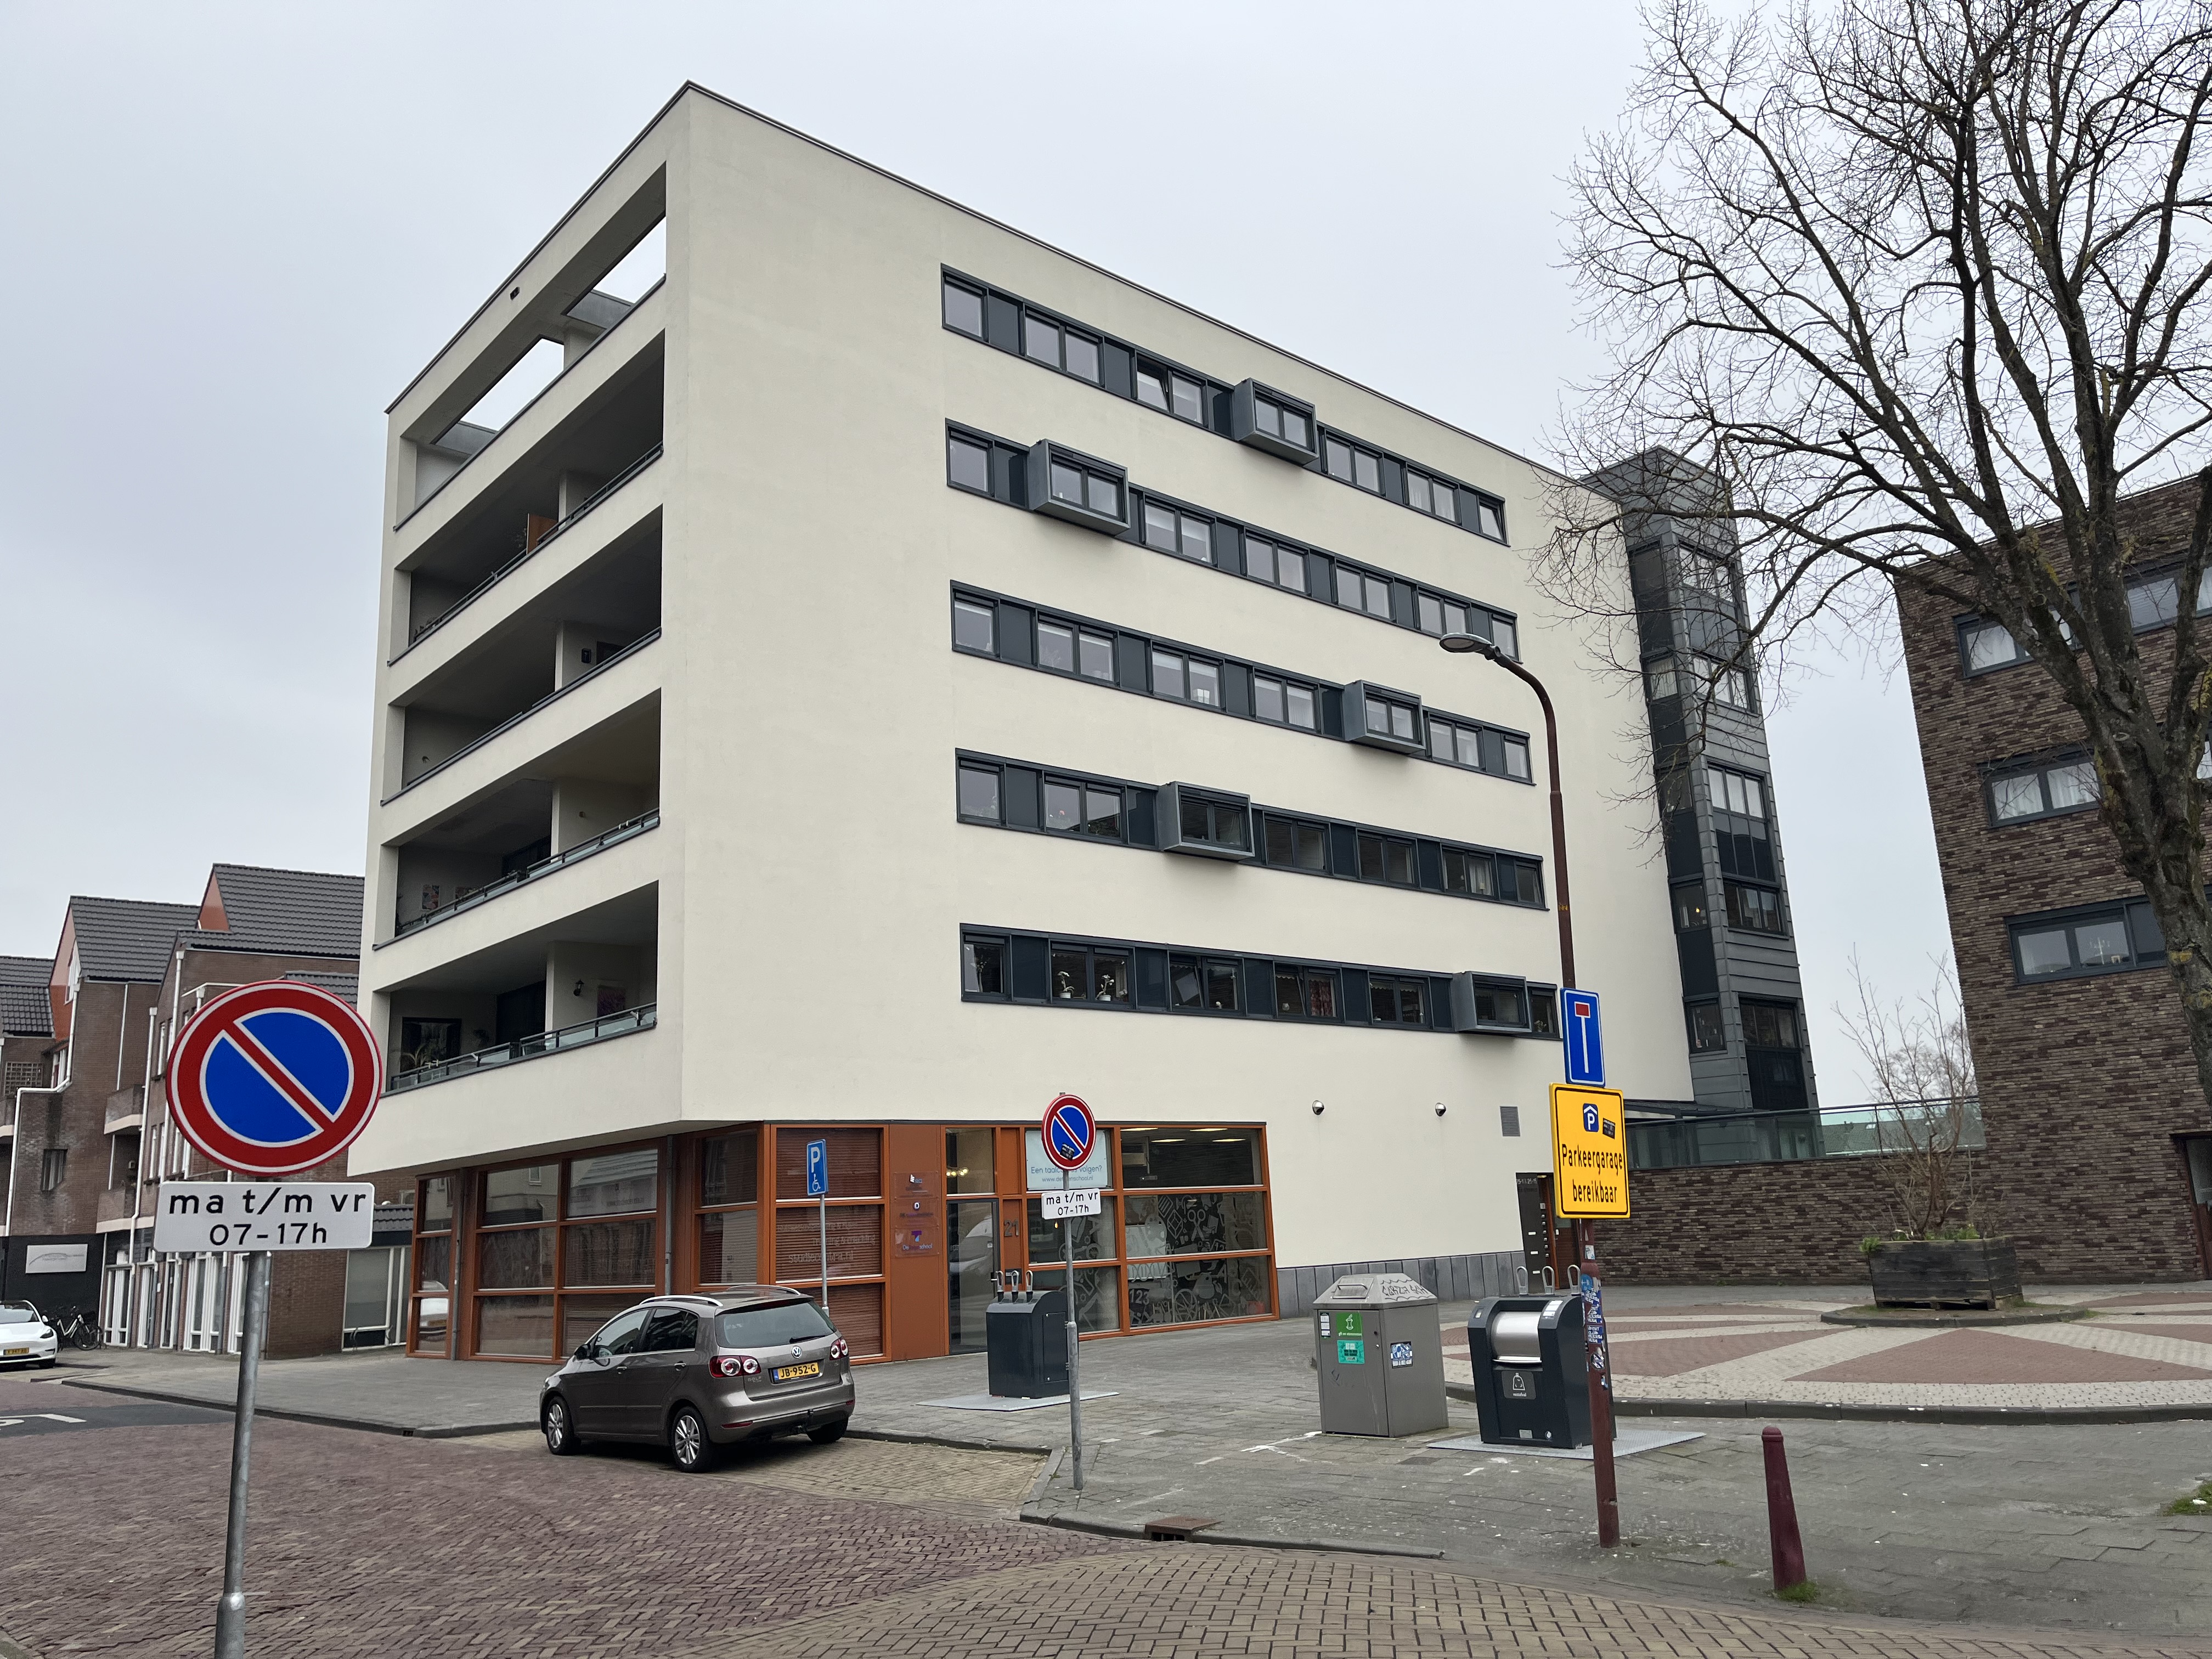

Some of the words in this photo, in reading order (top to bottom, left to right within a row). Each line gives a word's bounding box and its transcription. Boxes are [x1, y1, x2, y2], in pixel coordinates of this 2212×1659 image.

[810, 1147, 821, 1173] P
[1079, 1165, 1102, 1175] volgen?
[1561, 1143, 1623, 1176] Parkeergarage
[168, 1194, 224, 1215] ma
[242, 1187, 313, 1215] t/m
[330, 1193, 366, 1213] vr
[1046, 1196, 1060, 1205] ma
[1064, 1192, 1084, 1204] t/m
[1088, 1192, 1098, 1200] vr
[1572, 1178, 1617, 1203] bereikbaar
[1058, 1204, 1089, 1216] 07-17h
[210, 1222, 327, 1246] 07-17h
[1004, 1218, 1019, 1237] 21
[781, 1364, 816, 1378] JB-952-G
